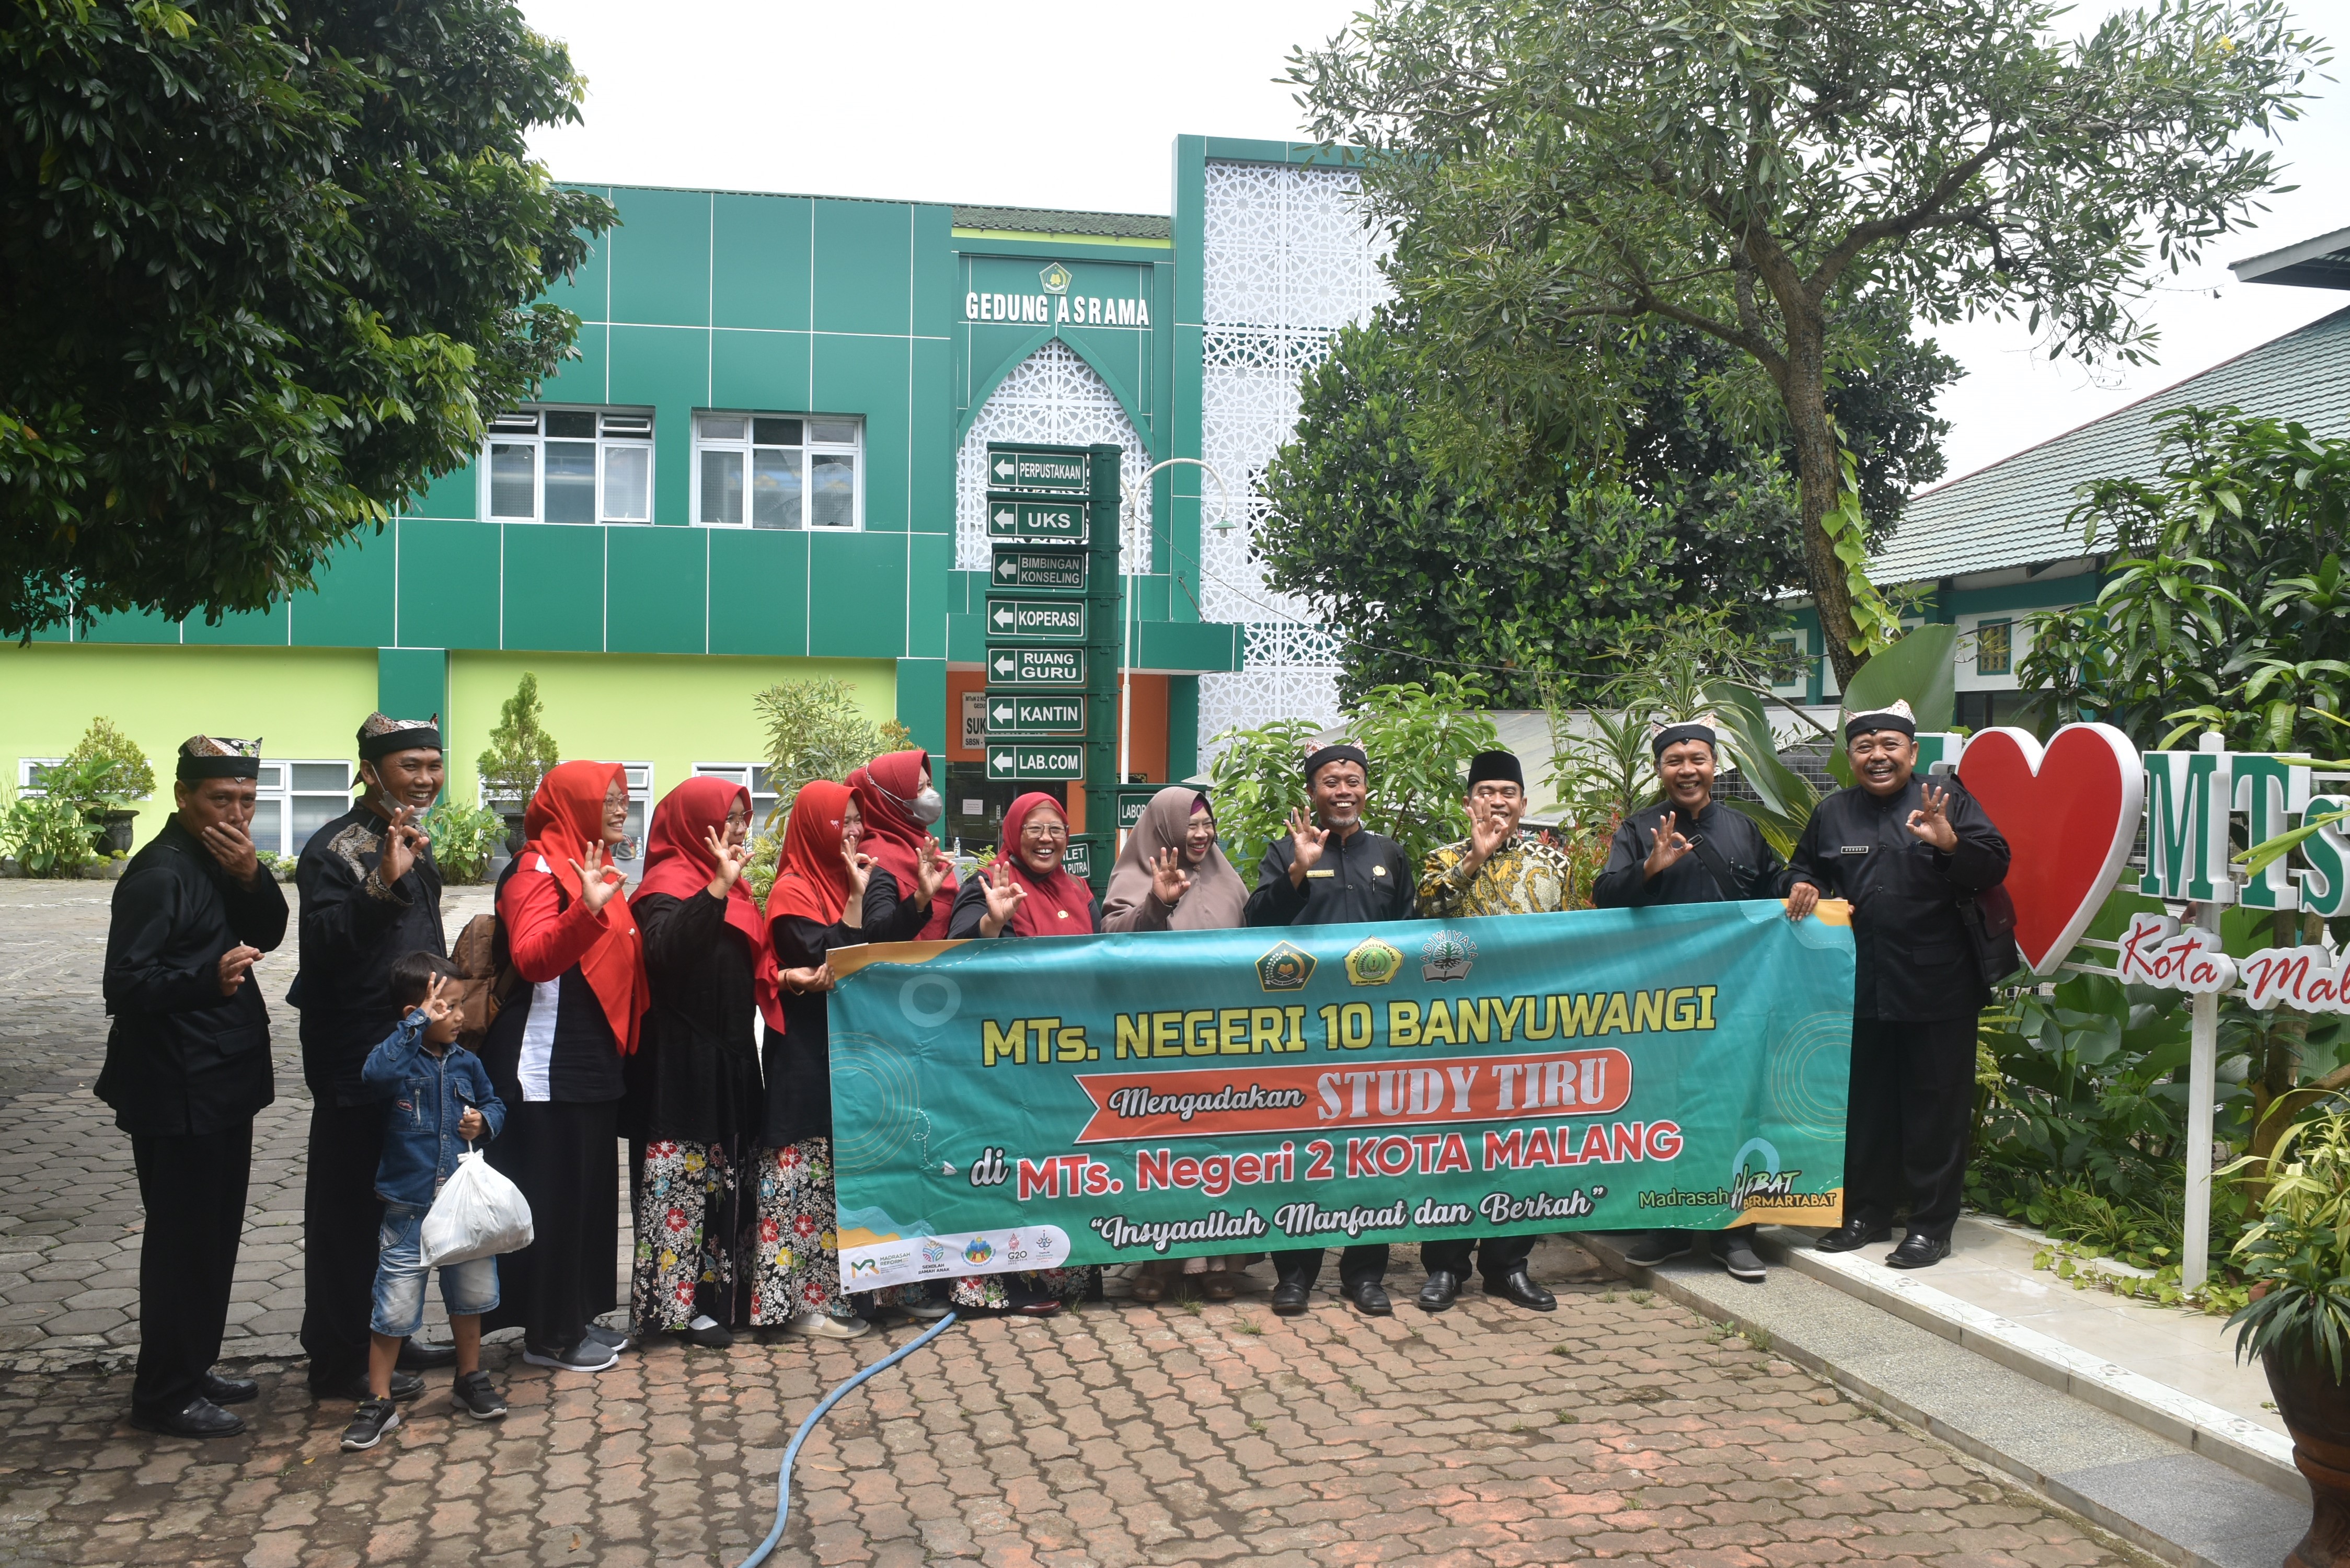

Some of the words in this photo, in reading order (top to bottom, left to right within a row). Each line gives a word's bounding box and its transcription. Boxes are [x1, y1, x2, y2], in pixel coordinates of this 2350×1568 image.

[966, 292, 1048, 322] GEDUNG
[1056, 296, 1149, 326] ASRAMA
[1020, 462, 1081, 480] PERPUSTAKAAN
[1028, 512, 1071, 528] UKS
[1021, 557, 1079, 570] BIMBINGAN
[1021, 571, 1079, 584] KONSELING
[1018, 610, 1079, 627] KOPERASI
[1023, 653, 1075, 665] RUANG
[1021, 666, 1077, 679] GURU
[1020, 706, 1078, 722] KANTIN
[966, 717, 986, 735] SUK
[1019, 754, 1078, 770] LAB.COM
[1068, 861, 1088, 874] PUTRA
[1420, 930, 1478, 963] ADIWIYATA
[2122, 921, 2217, 985] Kota
[2247, 955, 2350, 1005] Mal
[982, 1017, 1099, 1067] MTs.
[1114, 1005, 1306, 1059] NEGERI
[1318, 1000, 1374, 1051] 10
[1387, 985, 1718, 1047] BANYUWANGI
[1109, 1084, 1306, 1120] Mengadakan
[1316, 1065, 1479, 1120] STUDY
[1491, 1057, 1609, 1111] TIRU
[970, 1147, 1009, 1187] di
[1017, 1154, 1124, 1201] MTs.
[1136, 1140, 1295, 1197] Negeri
[1305, 1138, 1334, 1181] 2
[1346, 1132, 1472, 1179] KOTA
[1482, 1119, 1684, 1172] MALANG
[1639, 1186, 1729, 1209] Madrasah
[1743, 1192, 1837, 1210] BERMARTABAT
[1272, 1198, 1409, 1239] Manfaat
[1412, 1195, 1474, 1227] dan
[880, 1252, 911, 1261] MADRASAH
[880, 1258, 903, 1266] REFORM
